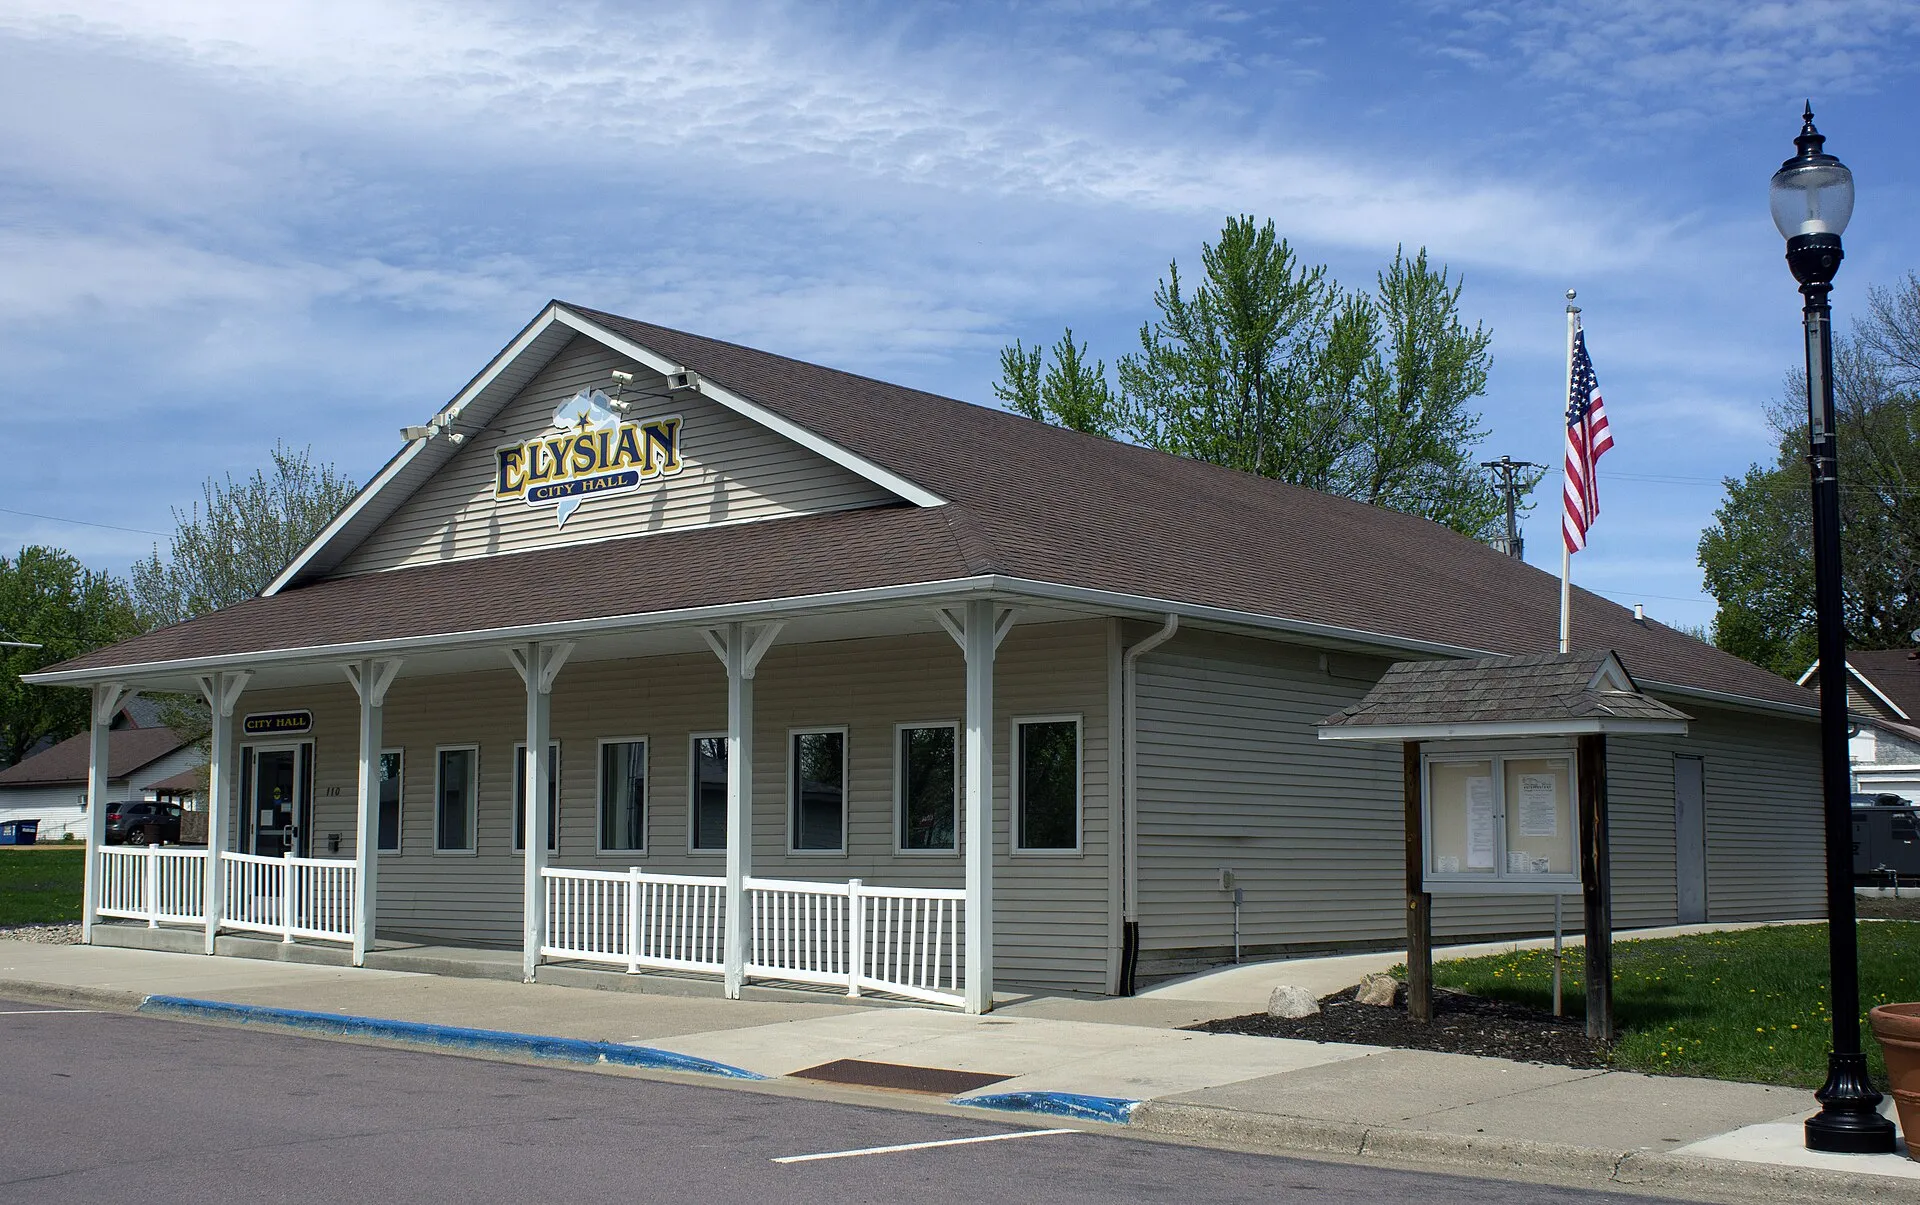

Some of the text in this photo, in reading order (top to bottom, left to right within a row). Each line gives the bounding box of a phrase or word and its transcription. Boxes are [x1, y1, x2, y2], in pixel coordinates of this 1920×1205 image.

[497, 418, 682, 497] ELYSIAN
[536, 475, 628, 500] CITY HALL
[247, 717, 307, 729] CITY HALL
[326, 787, 341, 797] 110
